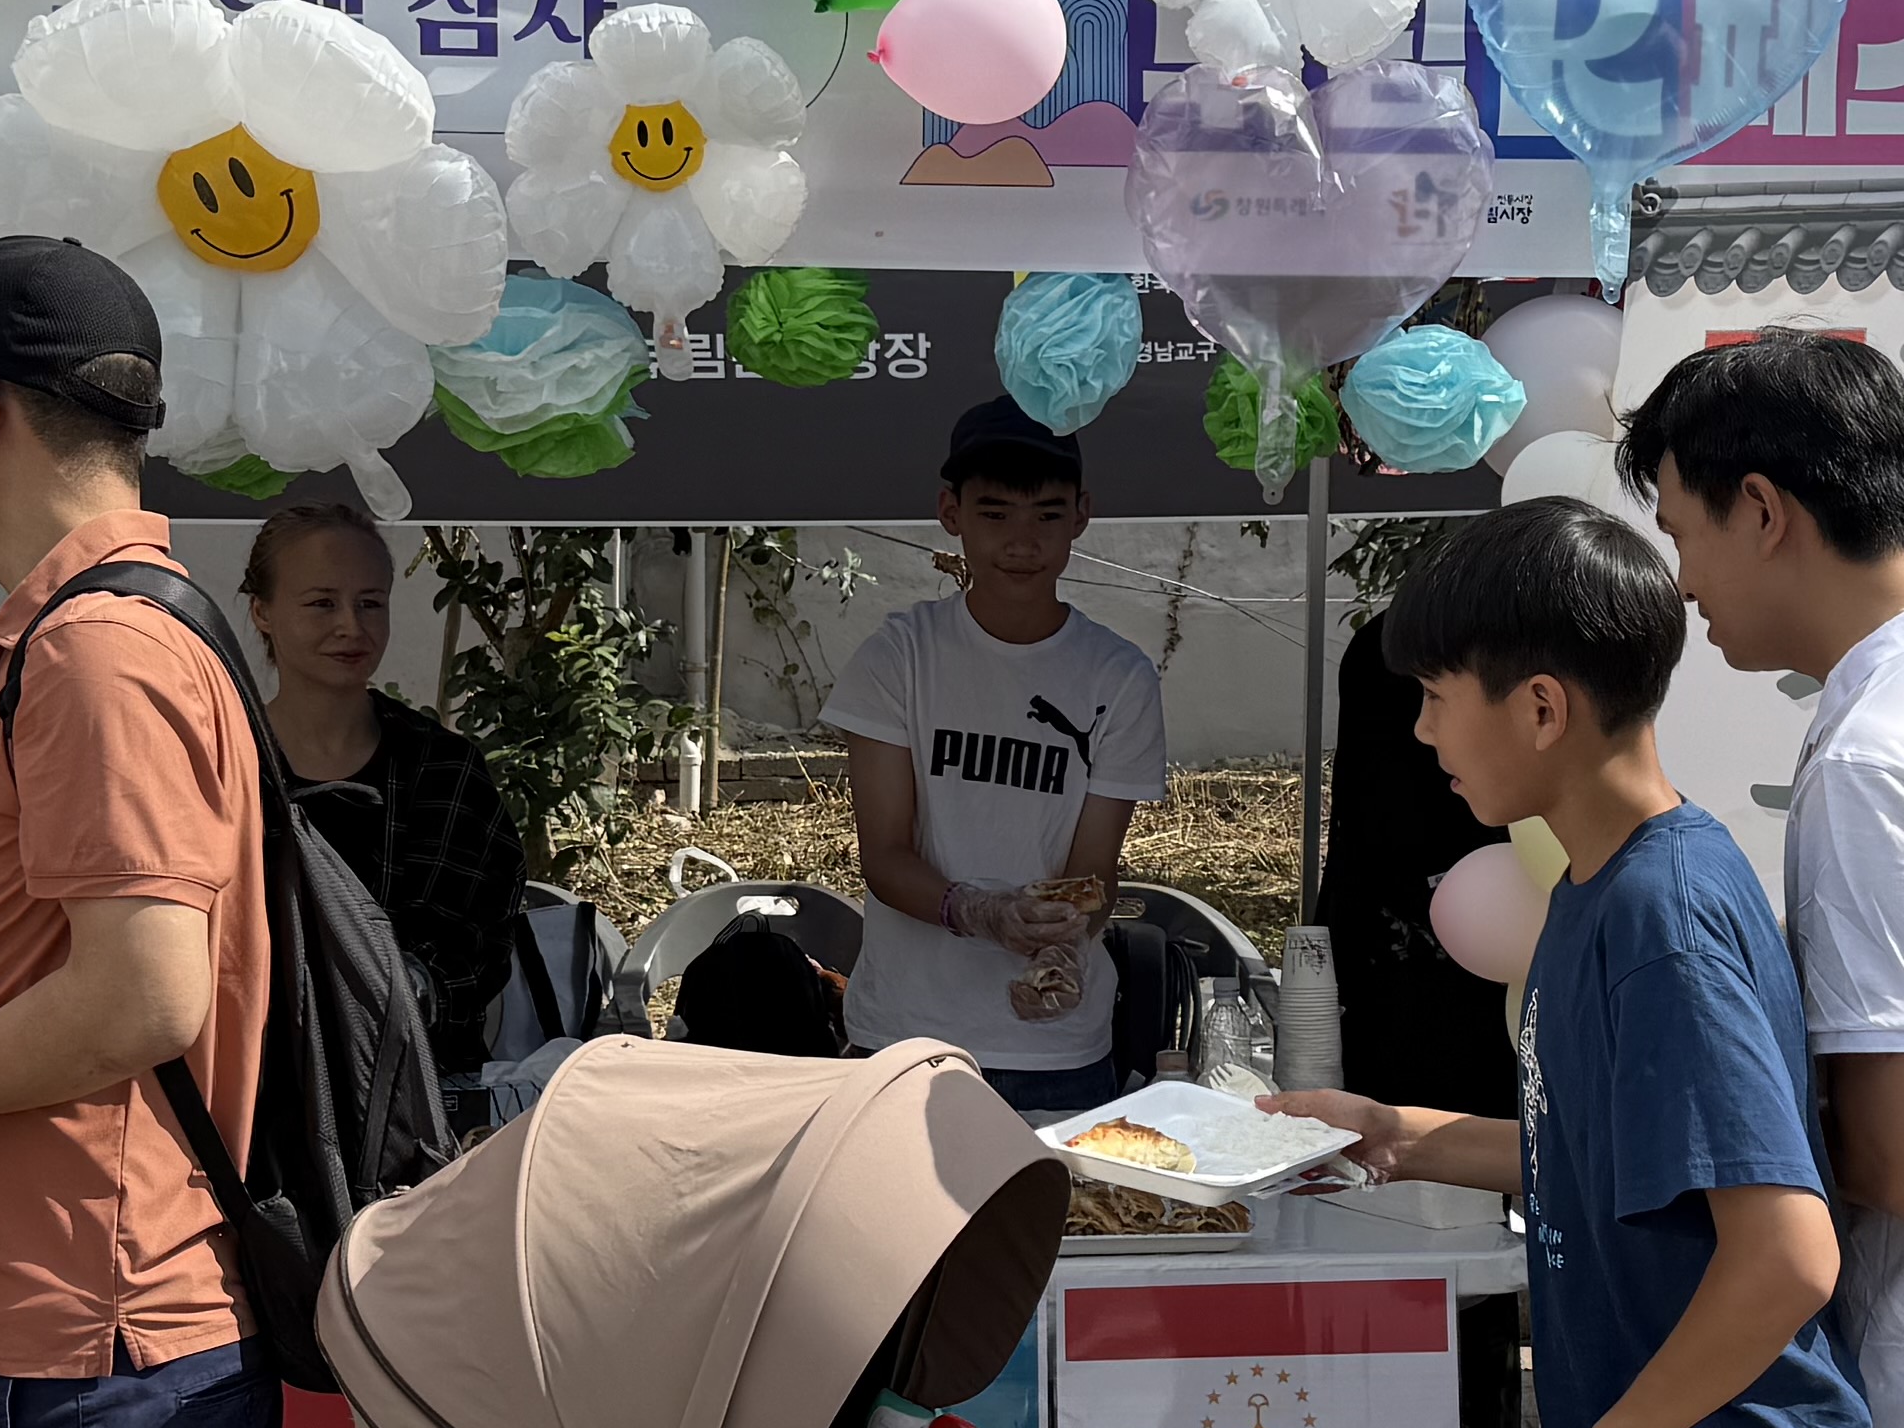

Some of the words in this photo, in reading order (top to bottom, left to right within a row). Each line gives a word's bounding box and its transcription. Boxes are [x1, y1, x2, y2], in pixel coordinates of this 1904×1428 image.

[1487, 205, 1534, 225] 림시장
[1136, 340, 1218, 363] 경남교구
[930, 728, 1070, 796] PUMA
